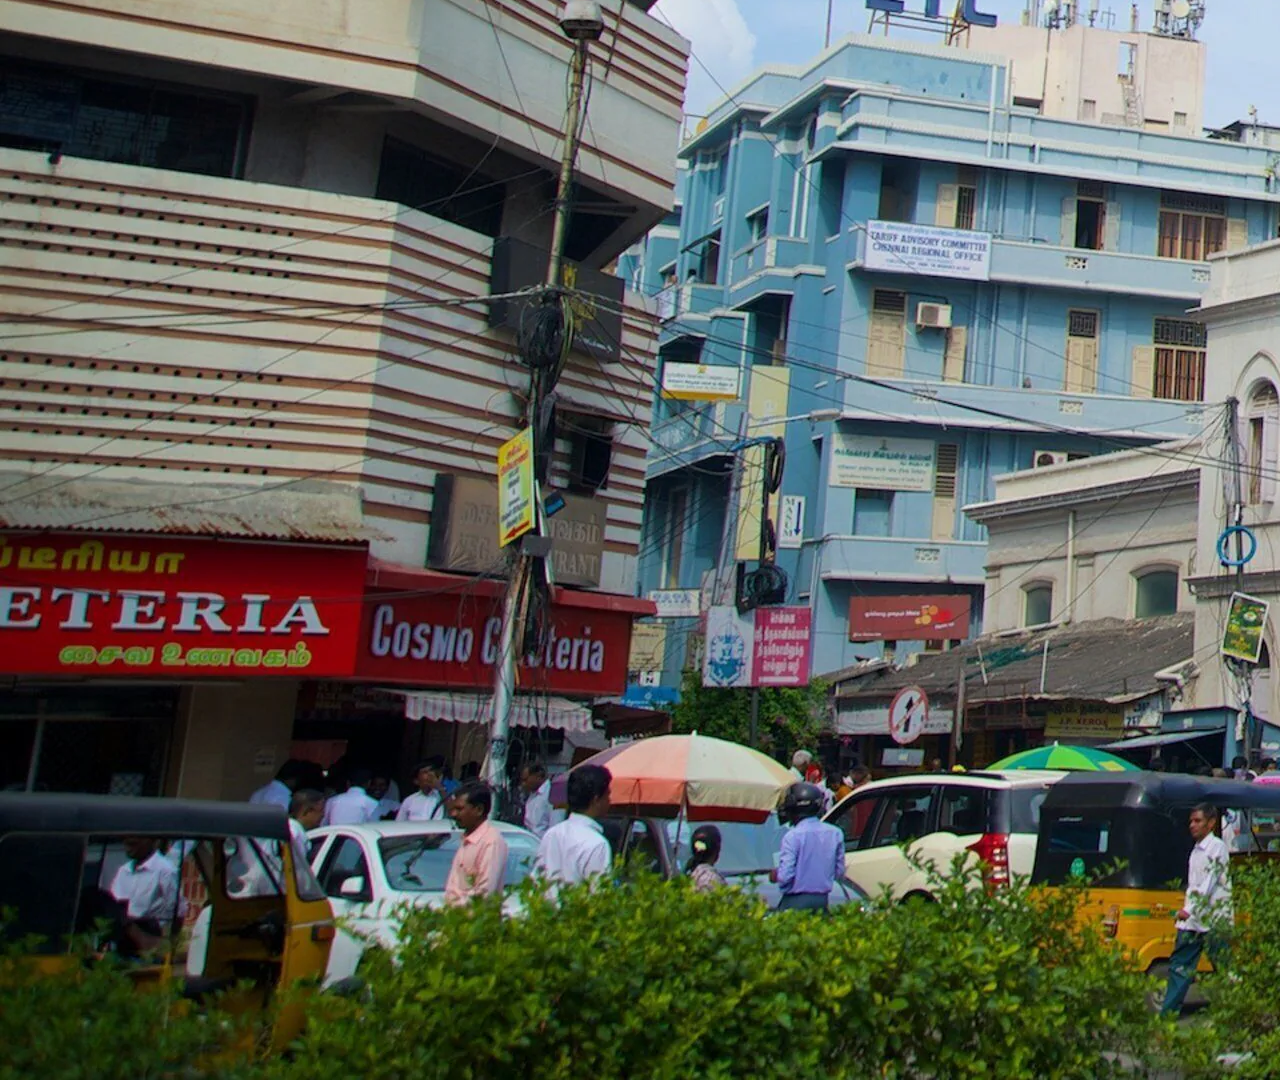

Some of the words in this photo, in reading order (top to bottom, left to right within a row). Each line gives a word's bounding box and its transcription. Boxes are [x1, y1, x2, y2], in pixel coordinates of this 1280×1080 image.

[900, 233, 939, 247] ADVISORY
[941, 239, 988, 252] COMMITTEE
[911, 245, 950, 259] REGIONAL
[954, 251, 983, 262] OFFICE
[59, 644, 154, 666] சைவ
[161, 641, 312, 668] உணவகம்
[481, 616, 605, 674] Cteria
[1076, 717, 1107, 725] XEROX
